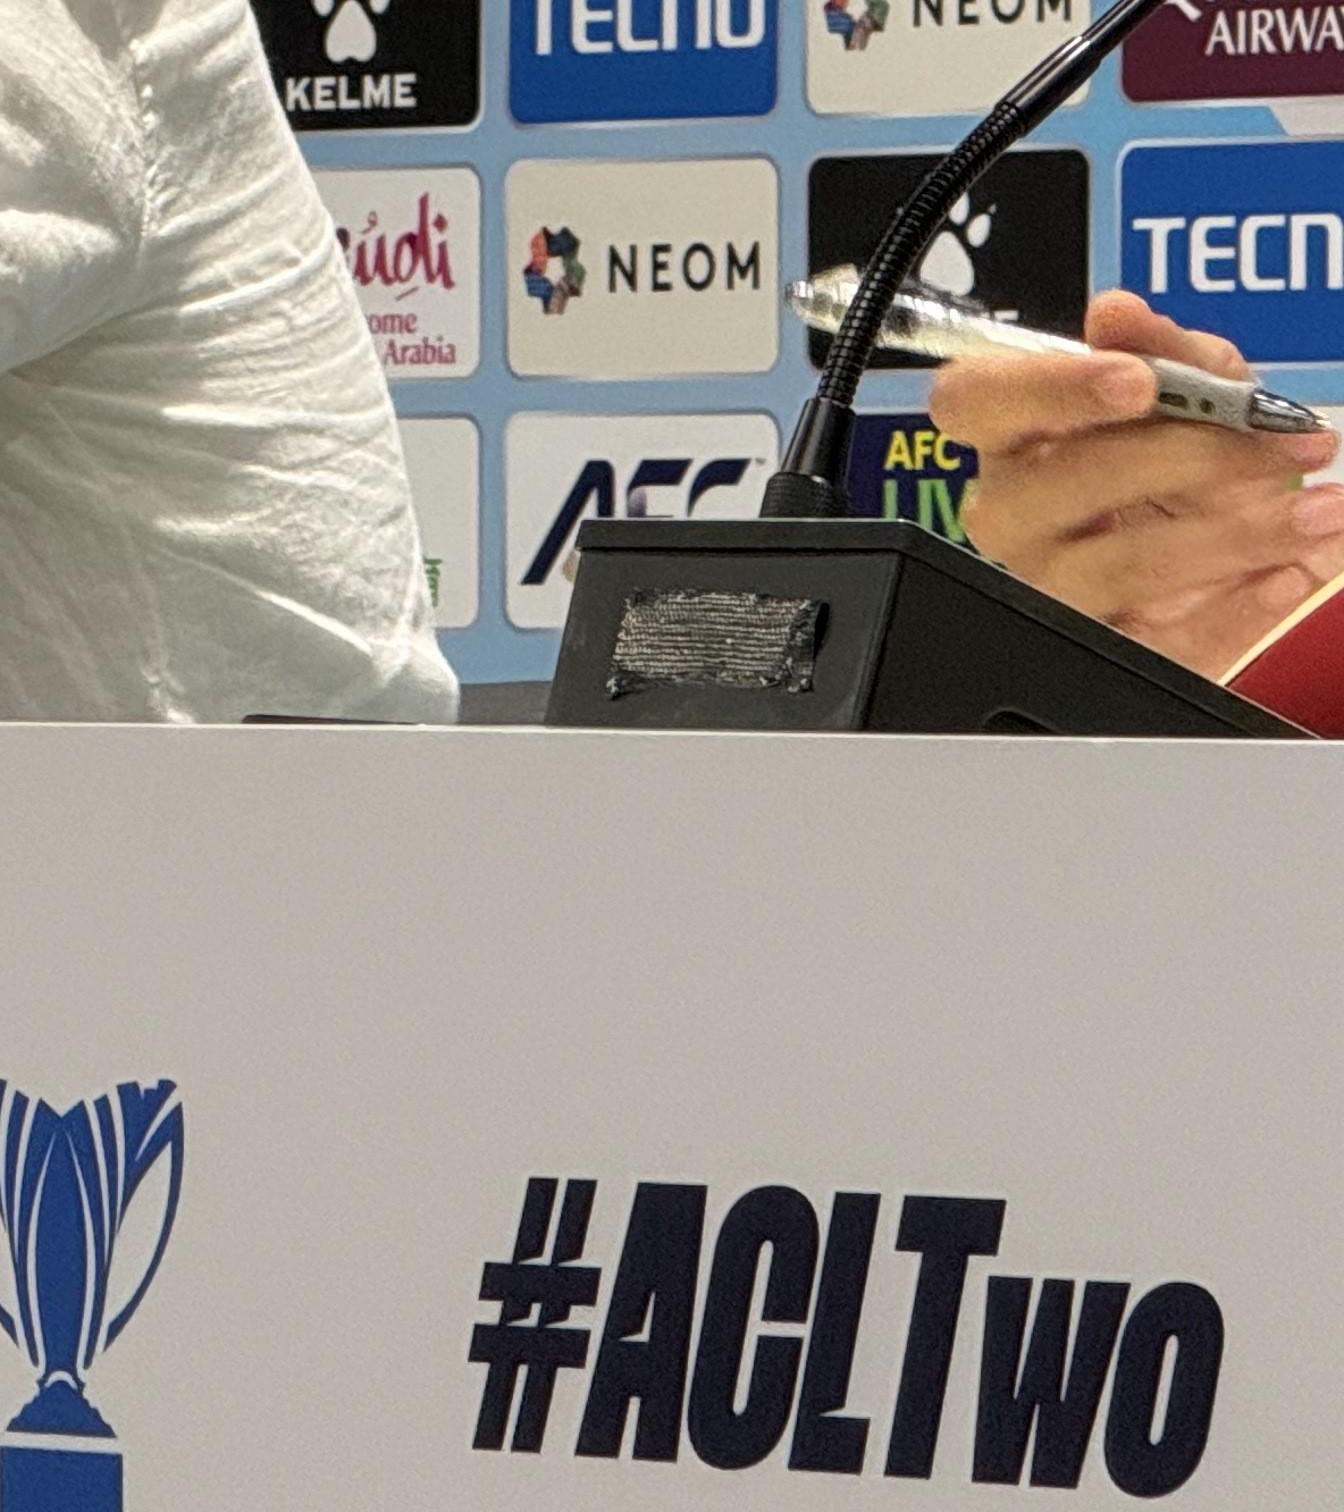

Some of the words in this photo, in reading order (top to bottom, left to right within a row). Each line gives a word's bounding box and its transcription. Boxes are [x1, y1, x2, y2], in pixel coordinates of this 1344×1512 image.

[1205, 6, 1344, 56] AIRWA
[284, 73, 419, 111] KELME
[607, 241, 761, 294] NEOM
[1132, 213, 1344, 294] TECN
